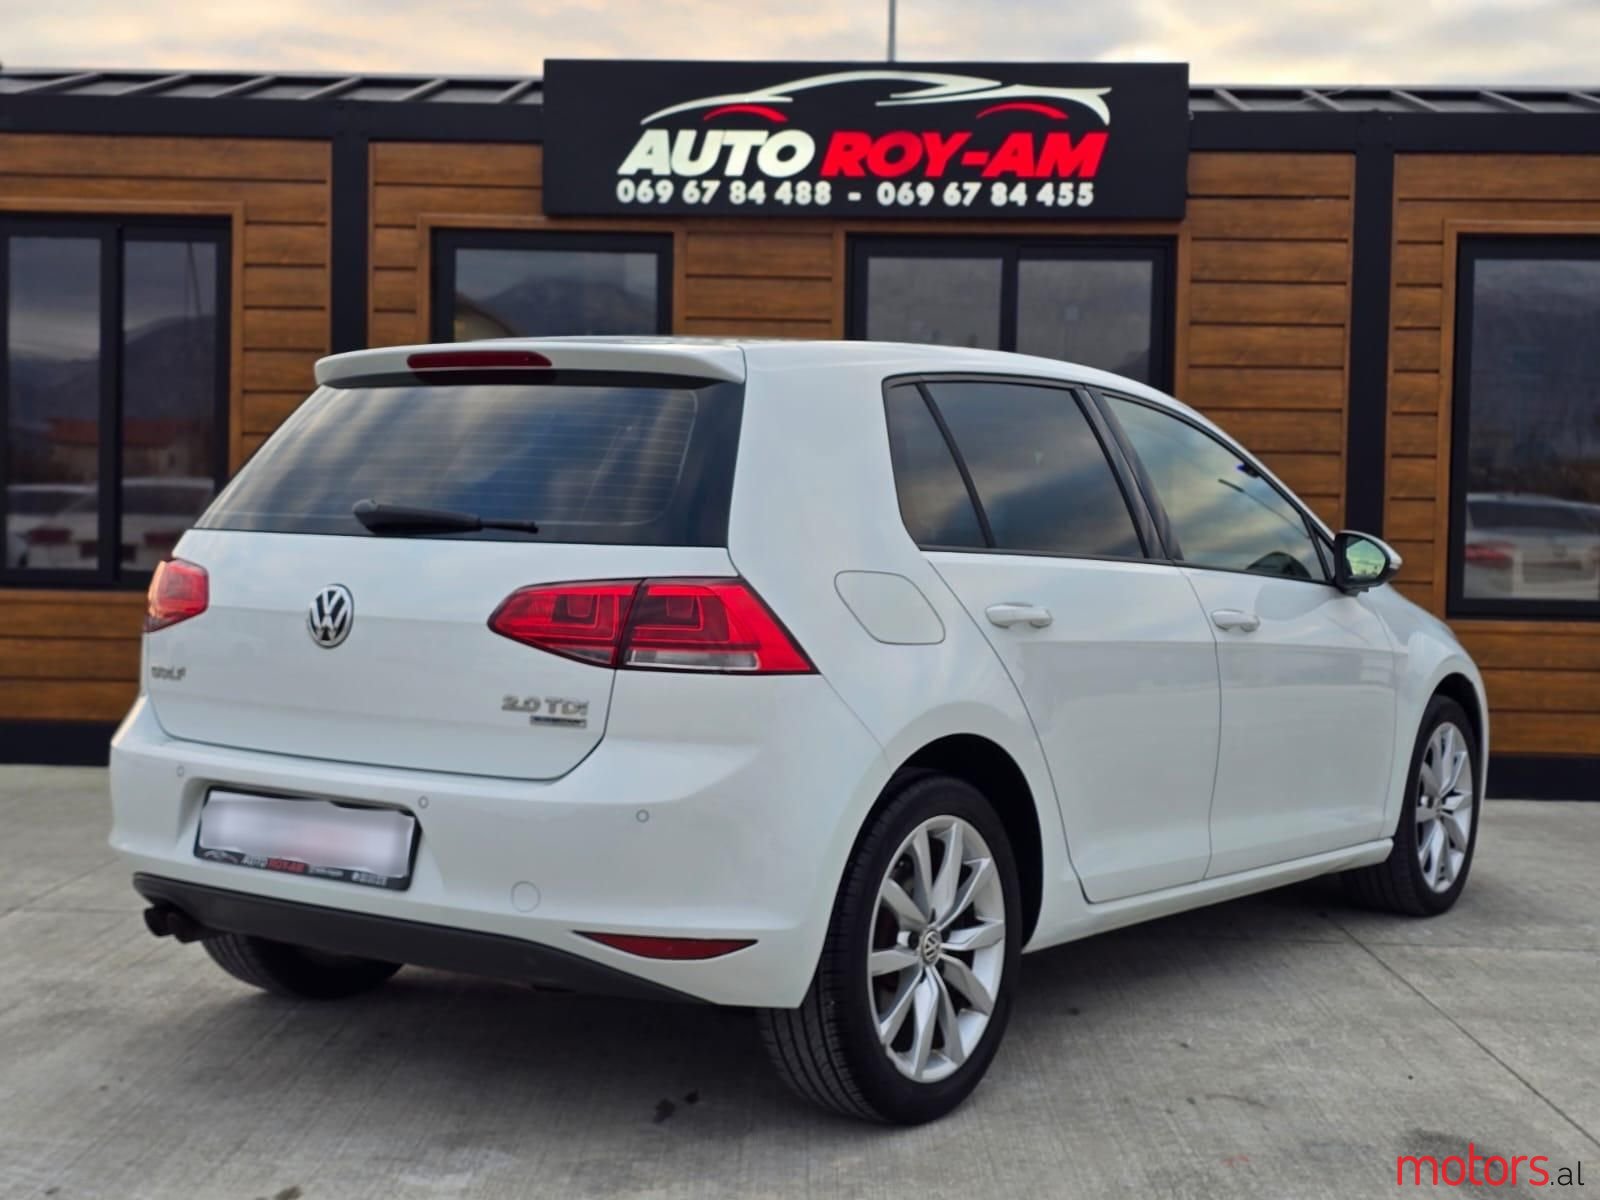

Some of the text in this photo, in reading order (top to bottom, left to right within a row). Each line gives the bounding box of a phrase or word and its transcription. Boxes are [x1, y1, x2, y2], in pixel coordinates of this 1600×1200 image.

[616, 129, 1109, 178] AUTO ROY-AM
[616, 178, 674, 204] 069
[682, 179, 721, 205] 67
[729, 180, 766, 205] 84
[774, 180, 832, 206] 488
[876, 180, 935, 206] 069
[943, 181, 982, 207] 67
[990, 181, 1028, 207] 84
[1036, 181, 1094, 207] 455
